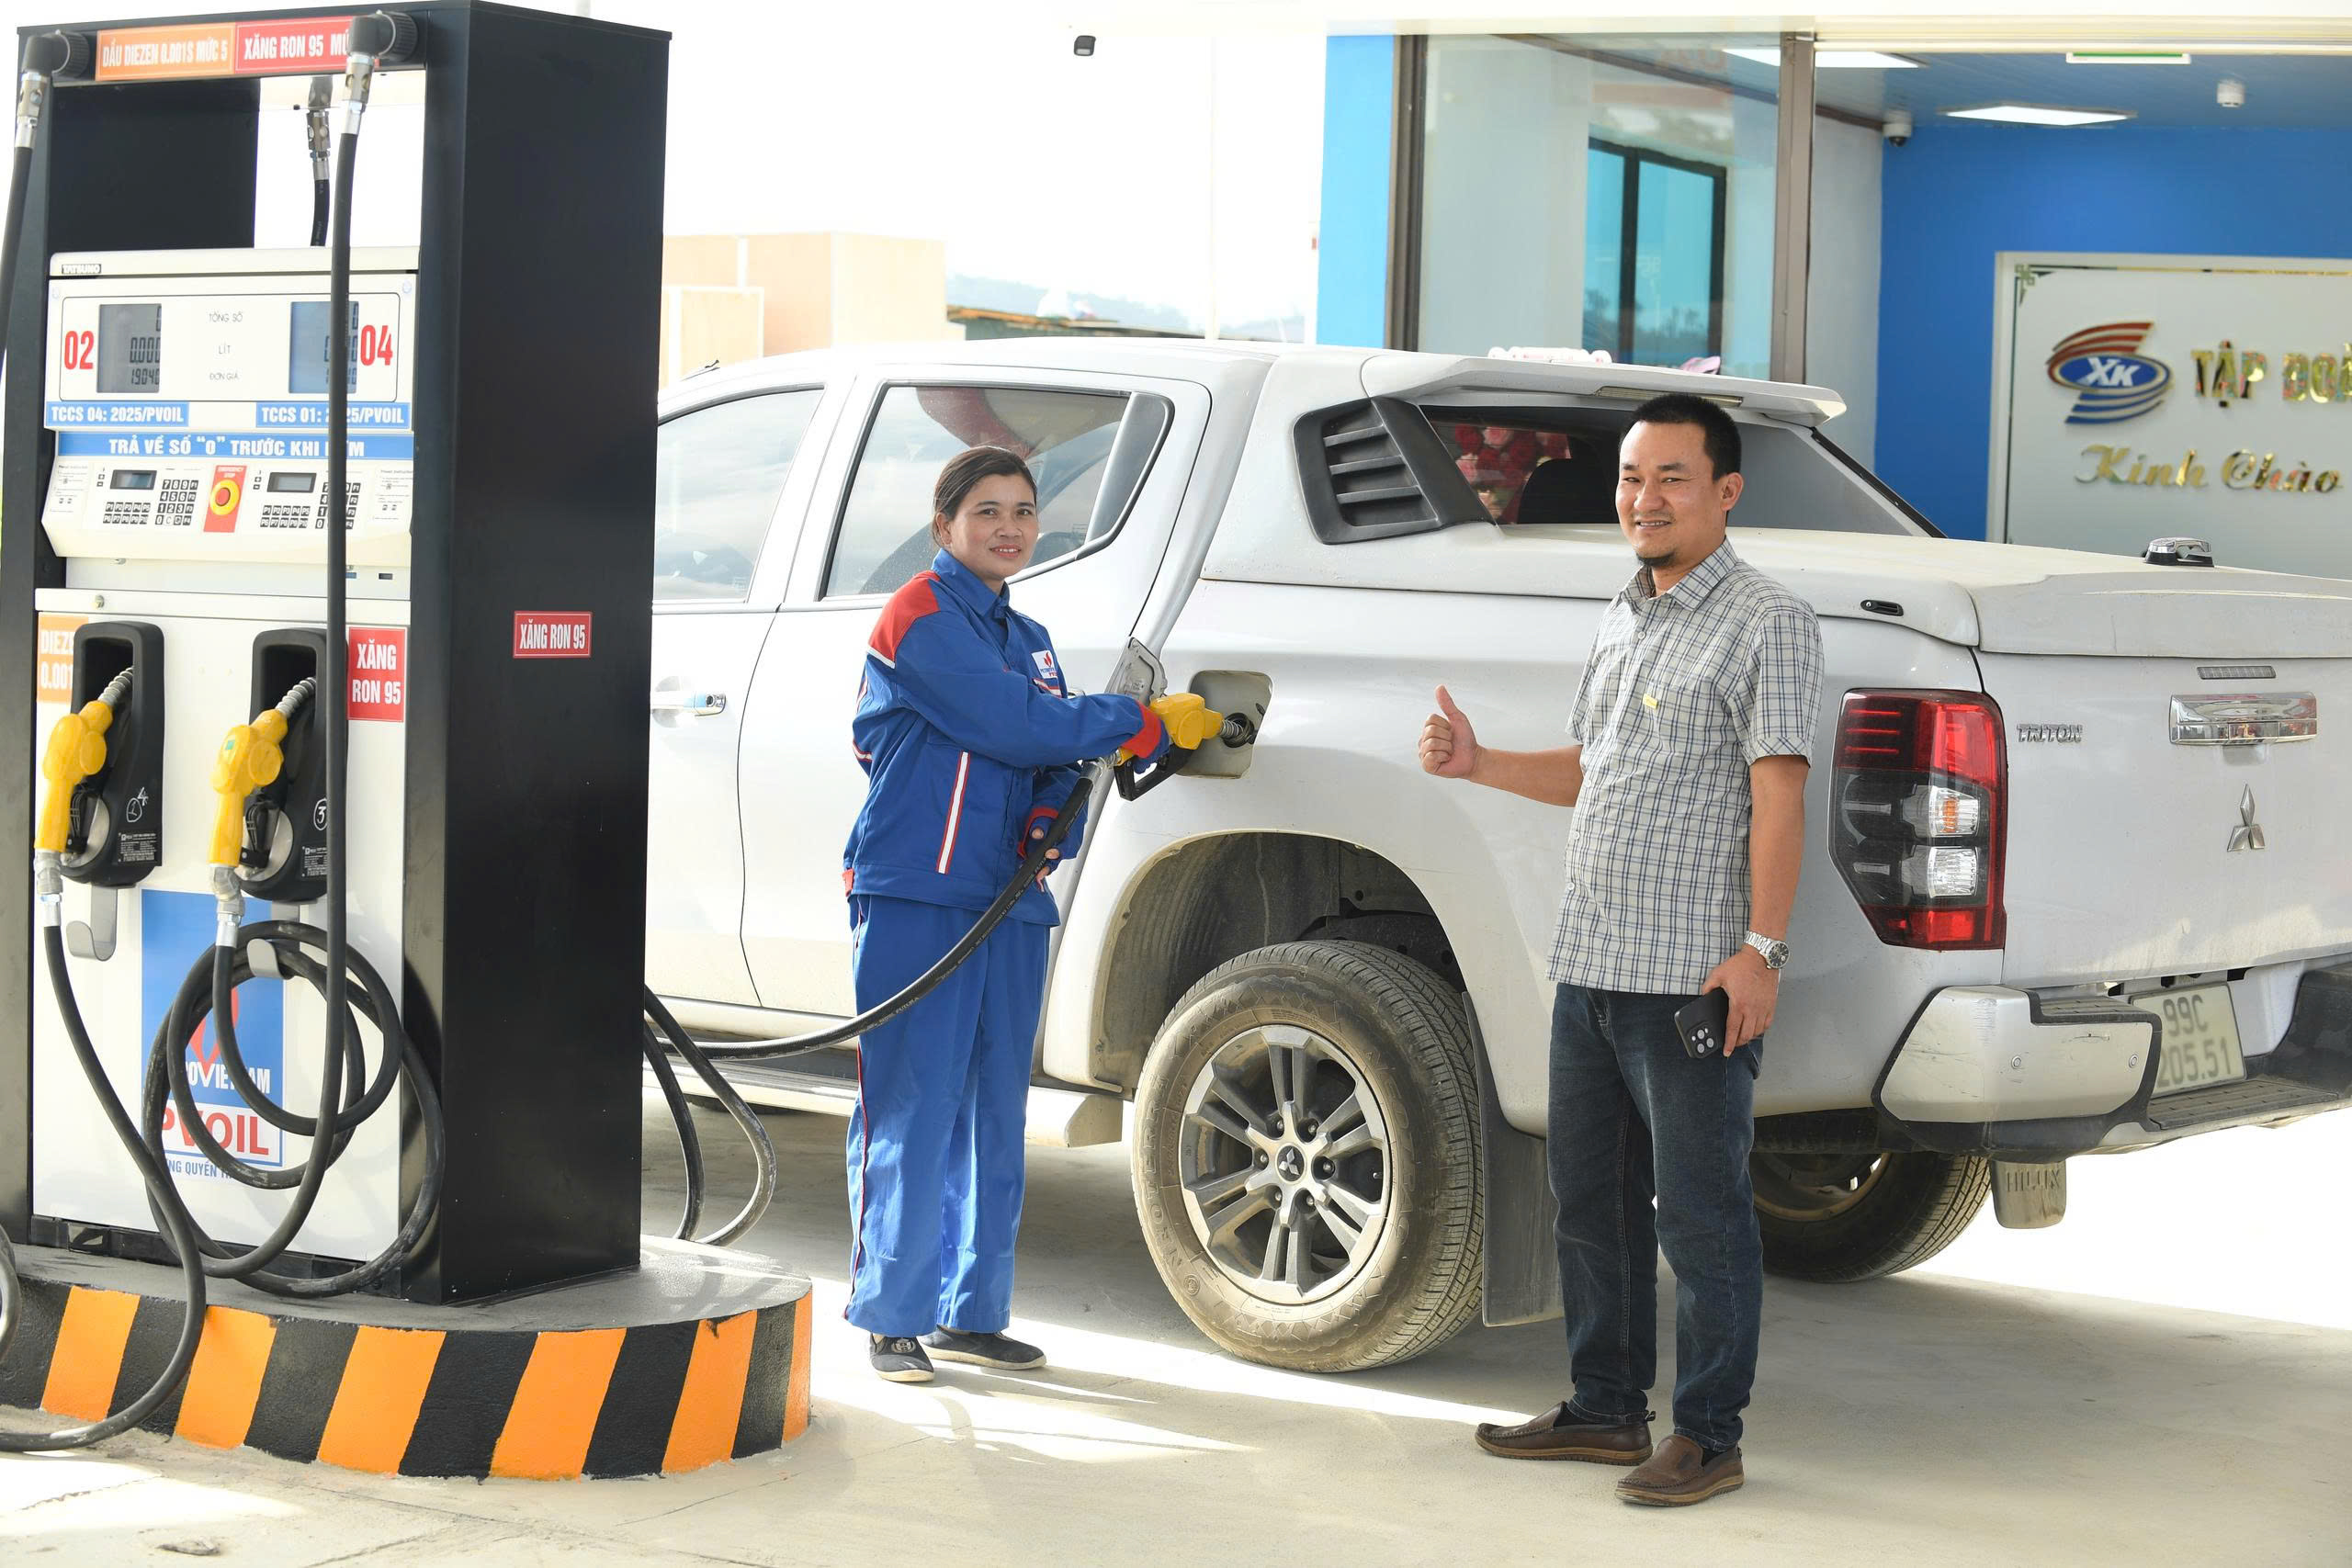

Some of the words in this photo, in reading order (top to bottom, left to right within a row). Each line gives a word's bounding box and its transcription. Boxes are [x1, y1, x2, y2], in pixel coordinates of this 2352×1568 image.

[124, 43, 159, 66] DIEZEN
[161, 41, 194, 64] 0.001S
[196, 37, 220, 63] MỨC
[220, 39, 228, 62] 5
[244, 32, 277, 60] XĂNG
[280, 35, 305, 58] RON
[309, 35, 323, 57] 95
[64, 331, 94, 369] 02
[360, 325, 392, 366] 04
[2078, 356, 2141, 387] XK
[2190, 340, 2267, 409] TẬP
[51, 407, 84, 422] TCCS
[87, 407, 107, 422] 04:
[110, 407, 184, 423] 2025/PVOIL
[262, 408, 297, 423] TCCS
[300, 408, 321, 423] 01:
[109, 434, 139, 455] TRẢ
[169, 435, 191, 455] SỐ
[231, 438, 285, 457] TRƯỚC
[290, 441, 320, 457] KHI
[2221, 448, 2344, 493] Chào
[40, 631, 74, 654] DIEZE
[519, 618, 548, 649] XĂNG
[549, 624, 571, 649] RON
[573, 624, 585, 649] 95
[356, 638, 397, 671] XĂNG
[41, 661, 74, 691] 0.001
[352, 680, 380, 704] RON
[384, 681, 401, 705] 95
[2017, 723, 2083, 743] TRITON
[2163, 994, 2209, 1037] 99C
